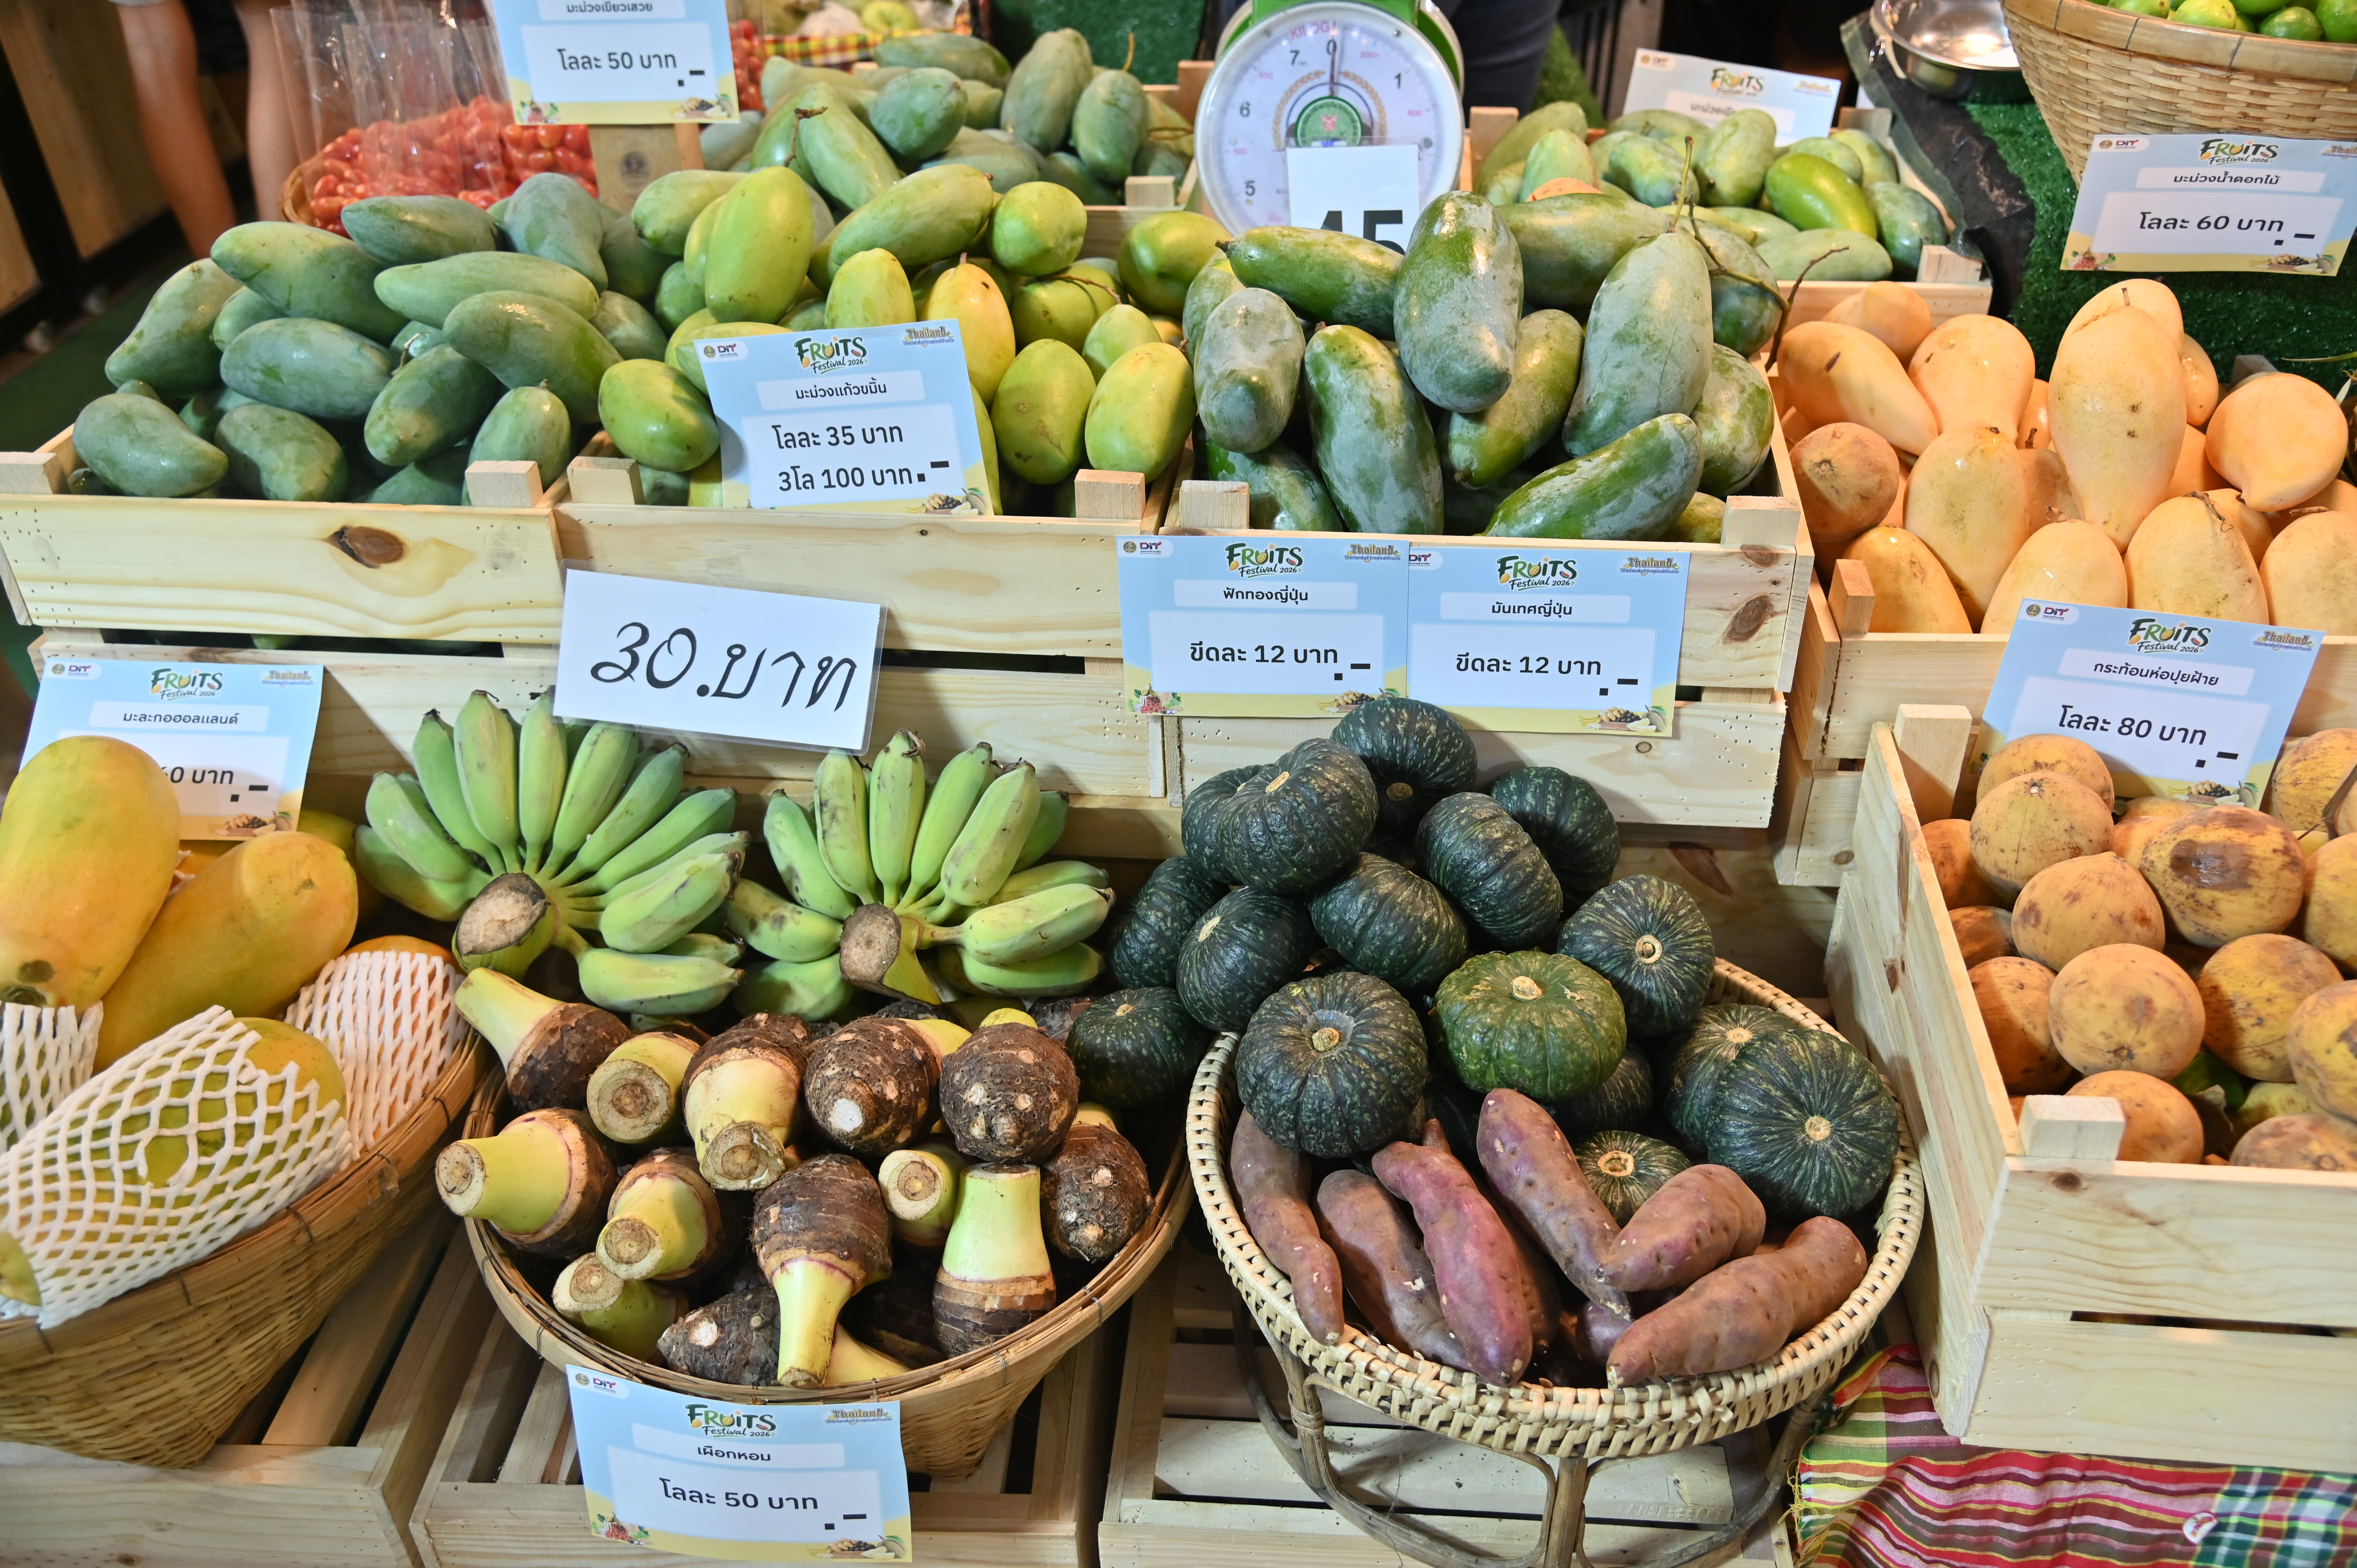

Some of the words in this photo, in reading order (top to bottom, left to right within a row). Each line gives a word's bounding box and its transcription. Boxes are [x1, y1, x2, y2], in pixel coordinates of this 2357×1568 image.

[1327, 39, 1337, 55] 0
[557, 49, 601, 70] โลละ
[608, 52, 633, 69] 50
[640, 54, 677, 69] บาท
[1290, 50, 1300, 66] 7
[1394, 73, 1402, 89] 1
[1240, 102, 1250, 117] 6
[2209, 155, 2251, 165] Festival
[2173, 171, 2281, 184] มะม่วงน้ำดอกไม้
[1245, 180, 1256, 196] 5
[2140, 212, 2189, 230] โลละ
[2197, 216, 2230, 230] 60
[2237, 219, 2284, 232] บาท
[906, 326, 947, 339] Thailand
[810, 356, 846, 374] Festival
[795, 377, 887, 399] มะม่วงแก้วขมิ้น
[771, 425, 821, 449] โลละ
[826, 426, 855, 446] 35
[862, 426, 903, 444] บาท
[778, 465, 815, 491] 3โล
[821, 467, 864, 489] 100
[871, 468, 912, 486] บาท
[1350, 544, 1394, 555] Thailand
[1238, 563, 1278, 577] Festival
[1627, 557, 1673, 568] Thailand
[1509, 576, 1550, 590] Festival
[1223, 585, 1308, 605] ฟักทองญี่ปุ่น
[1492, 599, 1572, 618] มันเทศญี่ปุ่น
[2263, 630, 2311, 645] Thailand
[1190, 641, 1246, 662] ขีดละ
[1254, 645, 1285, 663] 12
[1294, 649, 1338, 663] บาท
[2137, 641, 2181, 652] Festival
[1456, 652, 1511, 672] ขีดละ
[1520, 656, 1549, 674] 12
[1558, 660, 1601, 675] บาท
[2094, 662, 2219, 685] กระท้อนห่อปุยฝ้าย
[160, 687, 198, 700] Festival
[123, 713, 239, 724] มะละกอฮอลแลนด์
[2059, 705, 2111, 731] โลละ
[2117, 717, 2152, 738] 80
[2159, 726, 2206, 745] บาท
[162, 766, 184, 783] 0
[192, 770, 233, 784] บาท
[831, 1408, 884, 1418] Thailand
[701, 1426, 747, 1436] Festival
[698, 1445, 771, 1461] เผือกหอม
[659, 1477, 716, 1504] โลละ
[725, 1492, 758, 1508] 50
[768, 1497, 818, 1509] บาท
